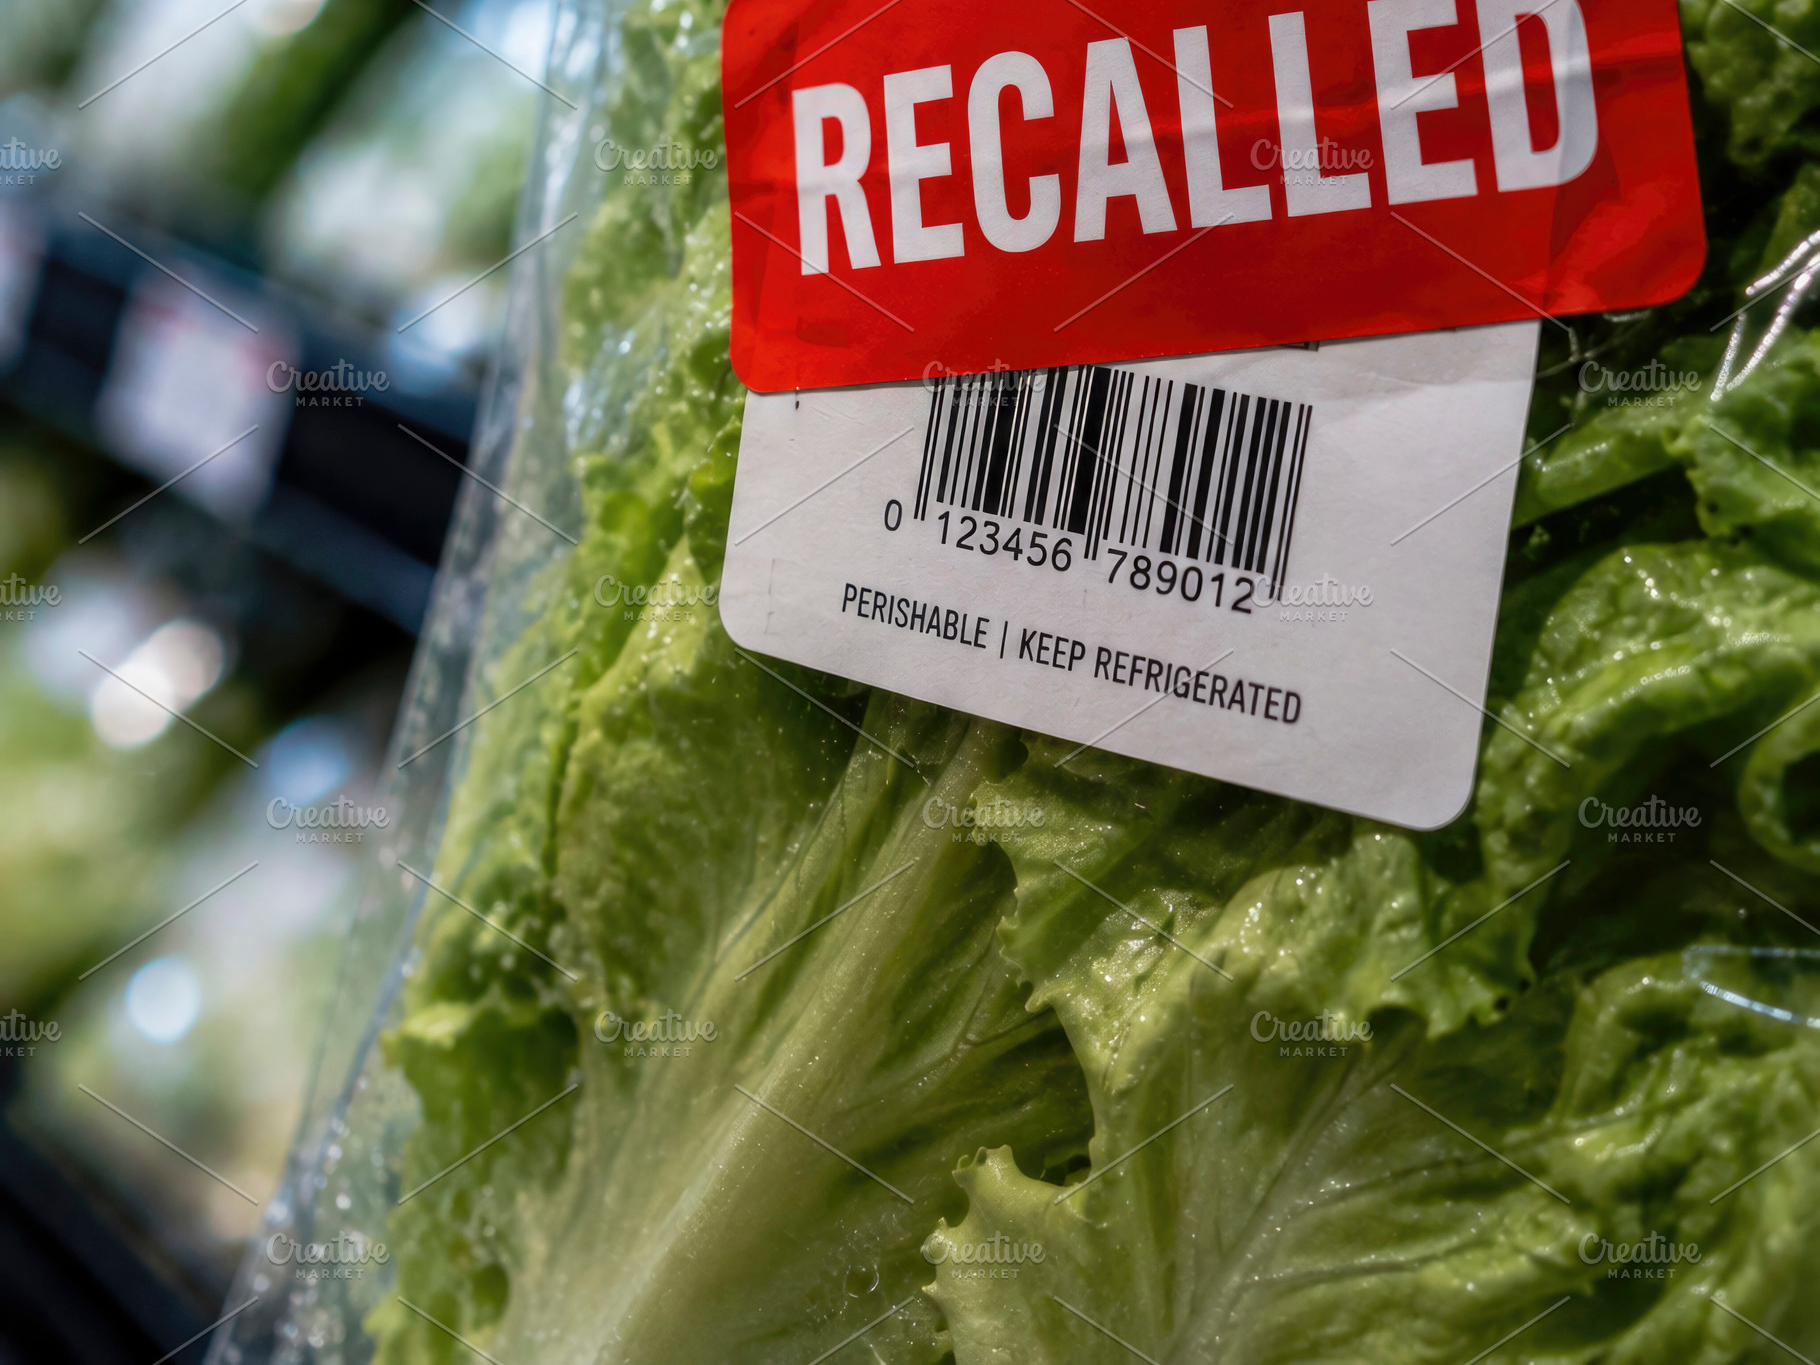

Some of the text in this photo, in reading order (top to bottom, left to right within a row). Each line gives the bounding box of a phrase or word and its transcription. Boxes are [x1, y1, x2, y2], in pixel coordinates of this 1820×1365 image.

[883, 498, 1255, 615] 0 123456 789012
[841, 582, 991, 649] PERISHABLE
[1018, 628, 1087, 673] KEEP
[1093, 646, 1302, 725] REFRIGERATED
